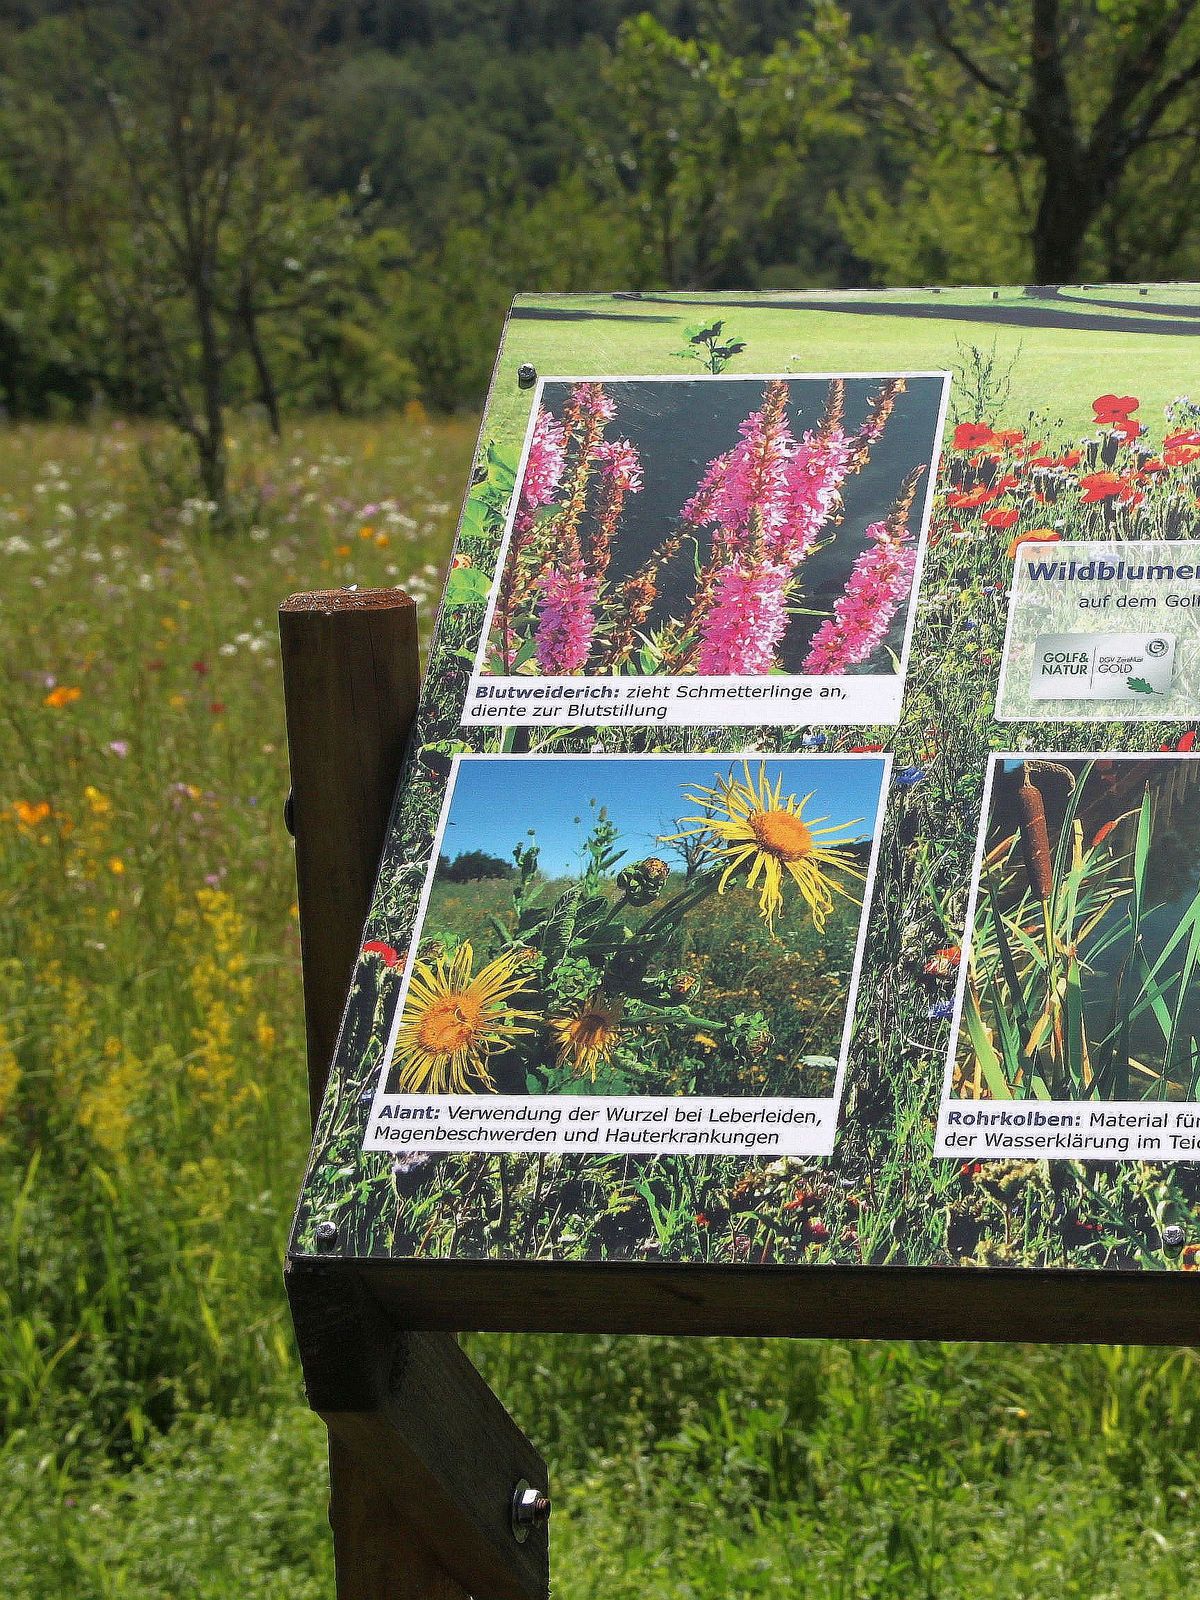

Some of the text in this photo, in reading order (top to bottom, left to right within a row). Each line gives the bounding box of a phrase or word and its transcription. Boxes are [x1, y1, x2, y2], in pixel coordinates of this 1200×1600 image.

[1079, 594, 1108, 608] auf
[1116, 594, 1157, 608] dem
[1043, 652, 1089, 665] GOLF&
[1042, 663, 1087, 675] NATUR
[1098, 663, 1133, 674] GOLD
[475, 684, 848, 701] Blutweiderich: zieht Schmetterlinge an,
[471, 703, 667, 720] diente zur Blutstillung
[378, 1105, 822, 1126] Alant: Verwendung der Wurzel bei Leberleiden,
[948, 1111, 1082, 1128] Rohrkolben:
[1089, 1112, 1169, 1128] Material
[374, 1126, 780, 1146] Magenbeschwerden und Hauterkrankungen
[944, 1132, 978, 1147] der
[985, 1133, 1130, 1151] Wasserklärung
[1137, 1135, 1161, 1150] im
